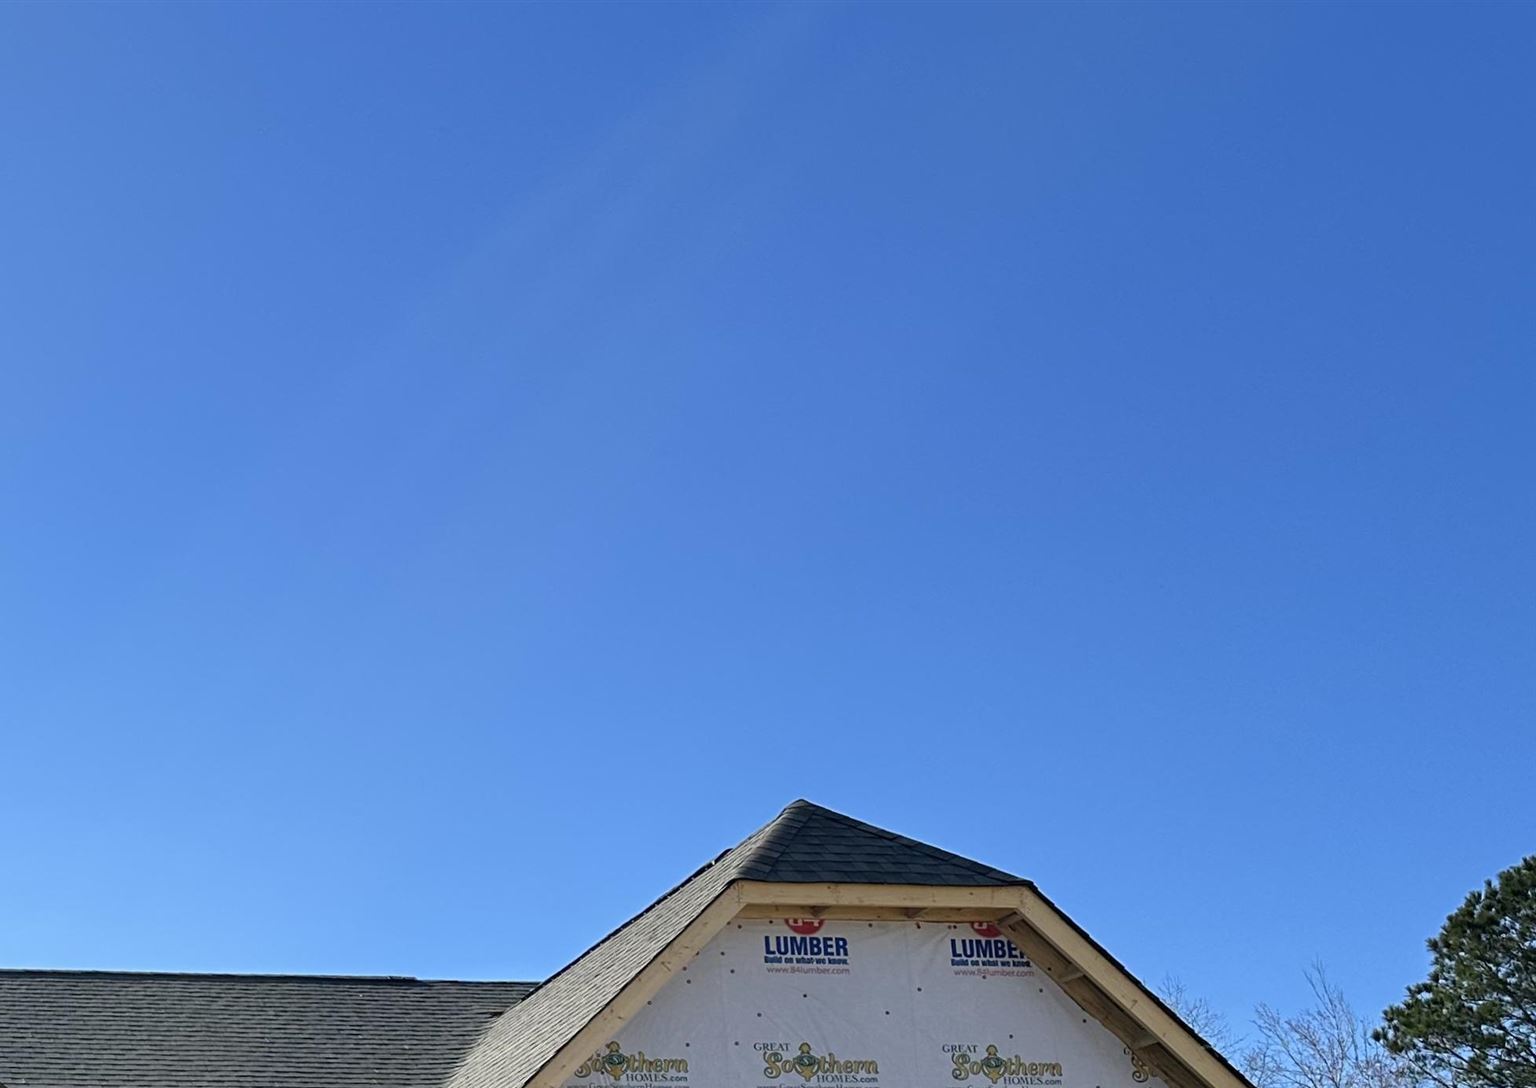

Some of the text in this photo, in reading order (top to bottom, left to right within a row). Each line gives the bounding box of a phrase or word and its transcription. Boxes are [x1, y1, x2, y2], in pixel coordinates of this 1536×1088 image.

[764, 936, 848, 956] LUMBER
[951, 939, 1024, 959] LUMBE
[754, 1042, 790, 1051] GREAT
[942, 1044, 978, 1053] GREAT
